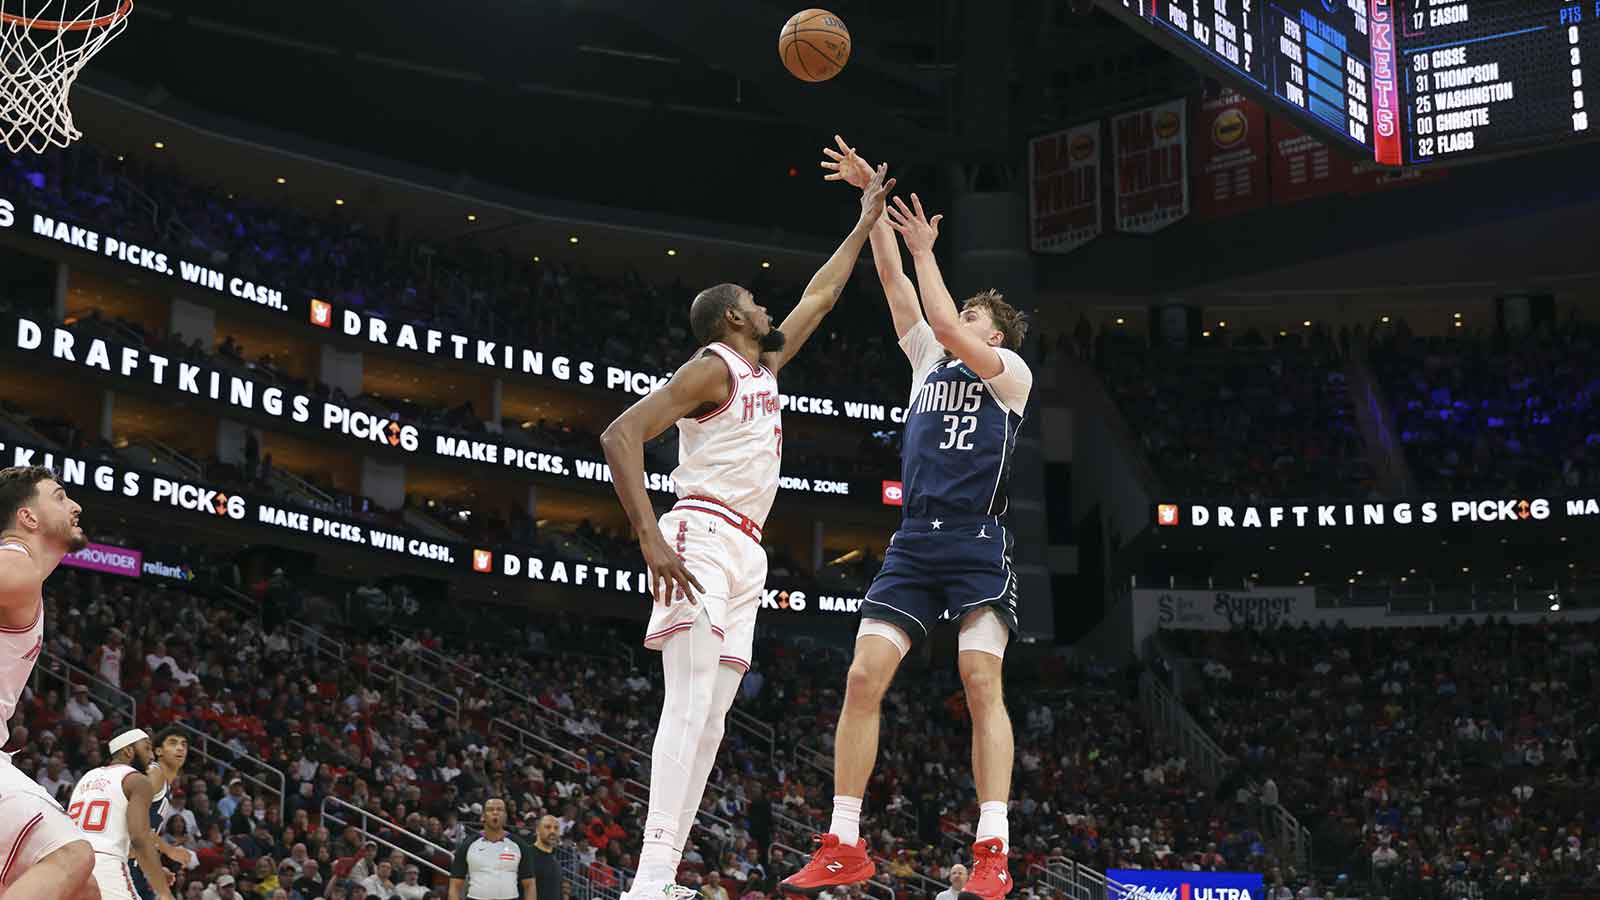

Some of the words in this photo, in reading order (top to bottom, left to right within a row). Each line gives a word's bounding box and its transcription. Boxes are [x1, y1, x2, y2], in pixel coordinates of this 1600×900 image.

[1413, 12, 1424, 30] 17
[1429, 4, 1468, 28] EASON
[1560, 6, 1581, 25] PTS
[1413, 53, 1428, 71] 30
[1432, 47, 1467, 69] CISSE
[1416, 75, 1428, 92] 31
[1433, 62, 1499, 90] THOMPSON
[1416, 95, 1431, 114] 25
[1434, 81, 1513, 110] WASHINGTON
[1417, 117, 1433, 135] 00
[1436, 107, 1490, 132] CHRISTIE
[1418, 138, 1434, 156] 32
[1437, 131, 1474, 153] FLAGG
[33, 214, 99, 252] MAKE
[104, 236, 174, 276] PICKS.
[180, 260, 224, 291] WIN
[229, 277, 288, 311] CASH.
[343, 310, 594, 385] DRAFTKINGS
[17, 318, 310, 423] DRAFTKINGS
[436, 435, 497, 463] MAKE
[503, 447, 570, 476] PICKS.
[779, 394, 839, 416] PICKS.
[844, 401, 885, 421] WIN
[916, 380, 984, 415] MAVS
[940, 415, 977, 451] 32
[813, 480, 848, 494] ZONE
[0, 442, 140, 496] KINGS
[259, 505, 309, 531] MAKE
[312, 517, 366, 544] PICKS.
[370, 530, 404, 552] WIN
[409, 539, 454, 563] CASH.
[1191, 502, 1437, 528] DRAFTKINGS
[143, 561, 182, 579] reliant
[68, 800, 111, 831] 20
[1194, 887, 1252, 900] ULTRA
